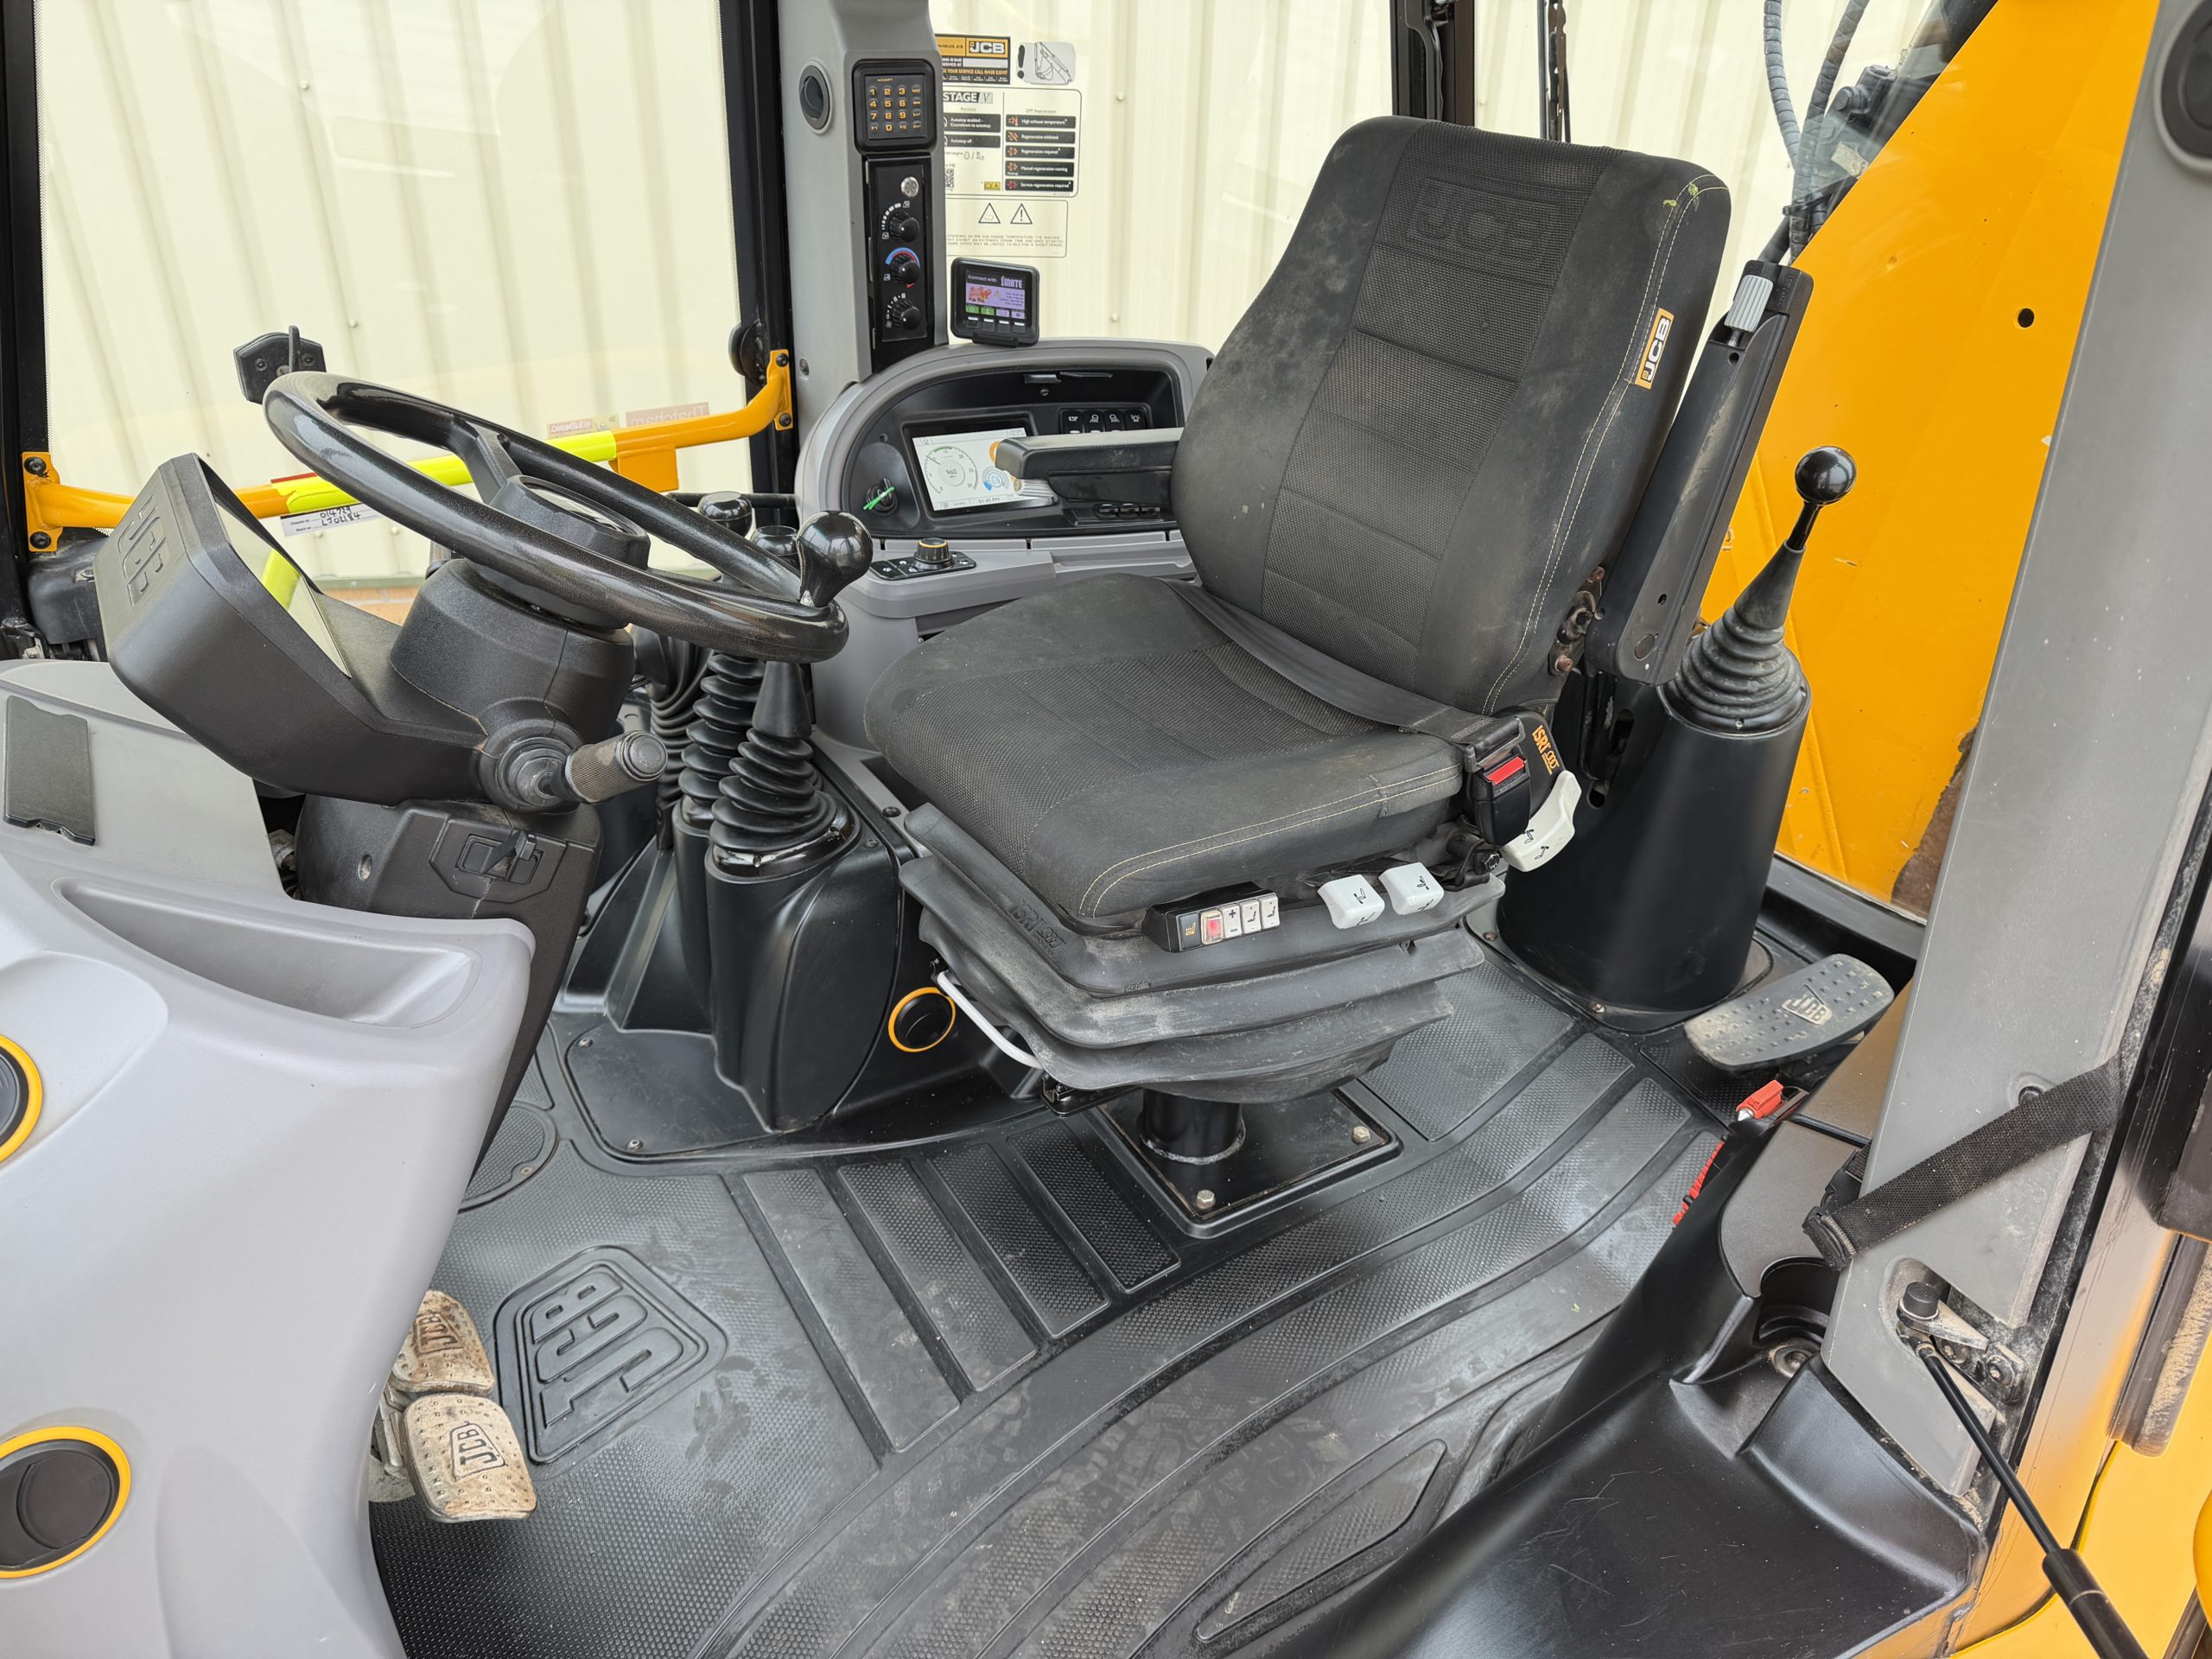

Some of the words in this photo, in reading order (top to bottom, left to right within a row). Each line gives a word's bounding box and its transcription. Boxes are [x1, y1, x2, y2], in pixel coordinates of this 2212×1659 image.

[969, 41, 1005, 54] JCB
[944, 92, 978, 102] STAGE
[1642, 317, 1670, 381] JCB
[420, 1313, 459, 1346] JCB
[530, 1271, 684, 1429] JCB
[458, 1428, 499, 1467] JCB
